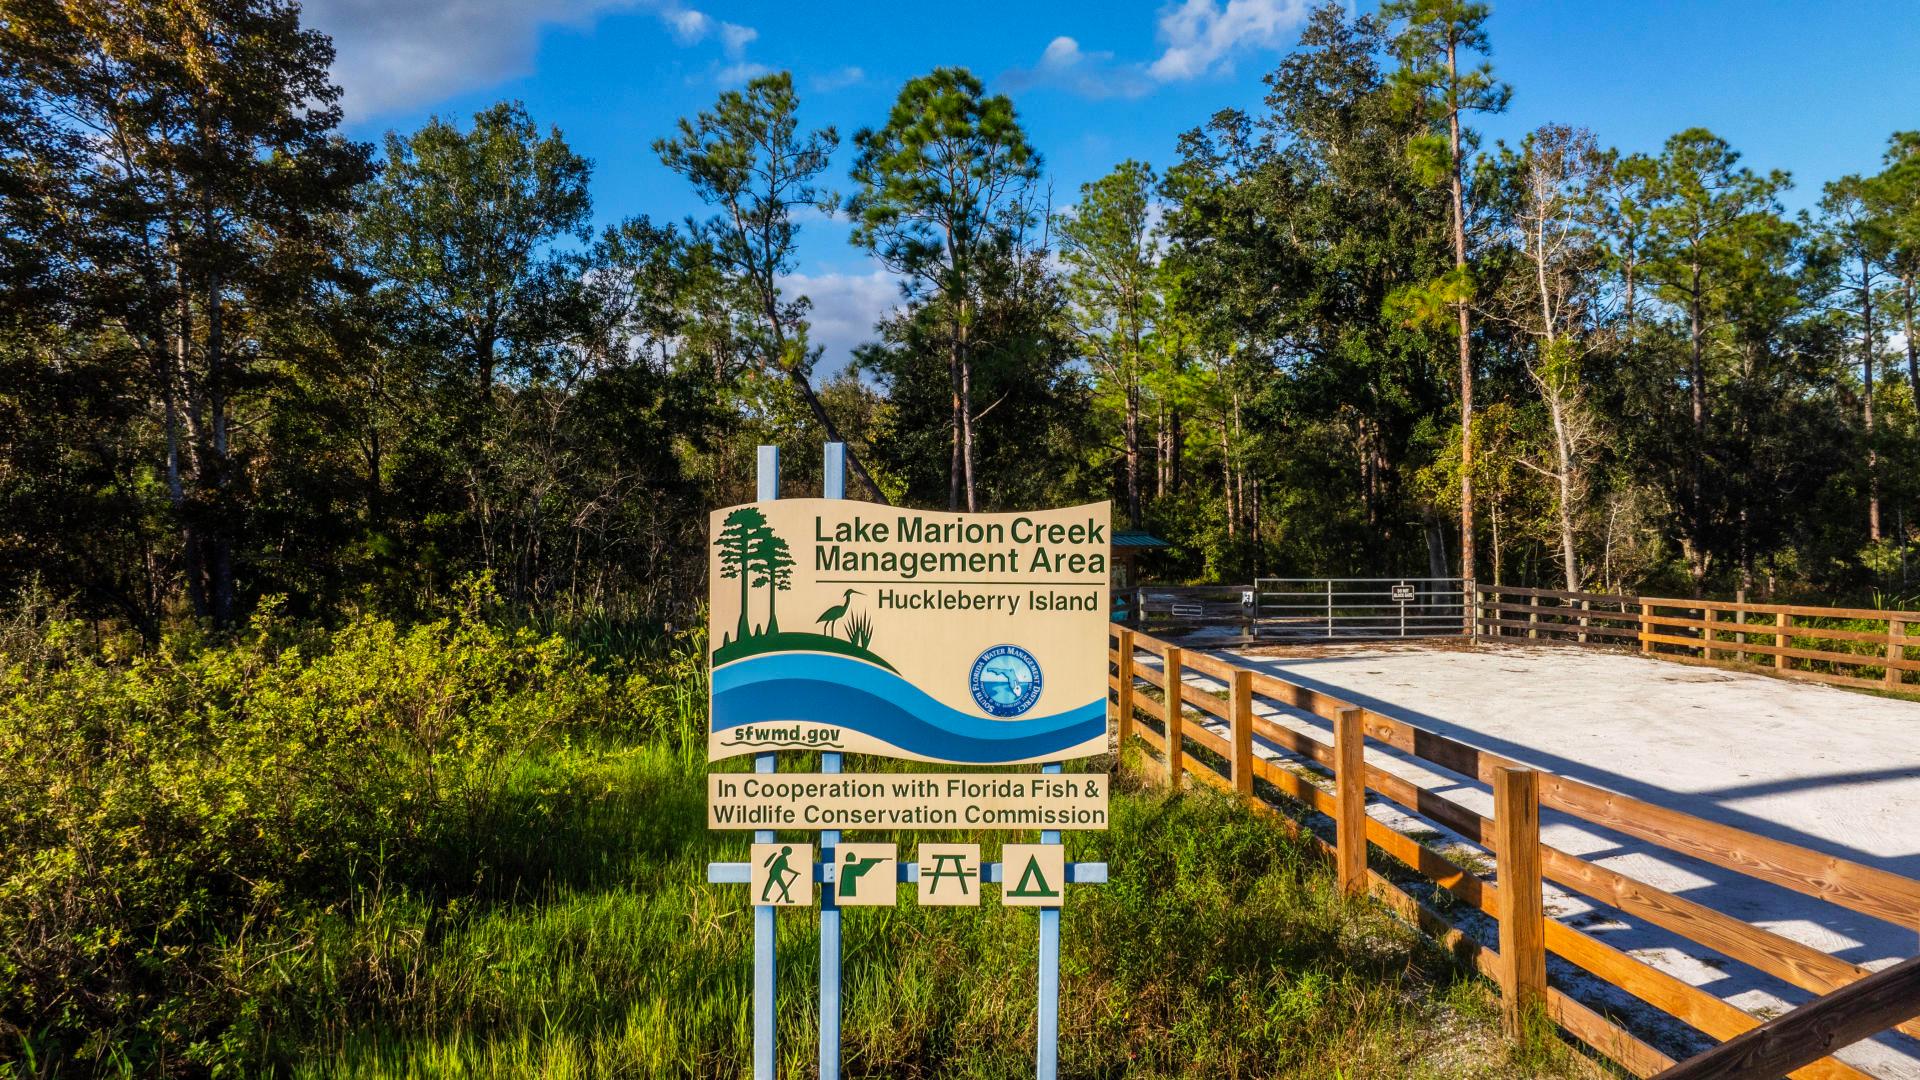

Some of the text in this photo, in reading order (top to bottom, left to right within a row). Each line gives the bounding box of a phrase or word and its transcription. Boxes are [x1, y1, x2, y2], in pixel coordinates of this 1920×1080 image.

[816, 517, 1104, 544] Lake Marion Creek
[816, 546, 1104, 578] Management Area
[879, 590, 1097, 615] Huckleberry Island
[735, 725, 840, 743] sfwmd.gov
[719, 780, 1099, 802] In Cooperation with Florida Fish &
[714, 805, 1104, 823] Wildlife Conservation Commission
